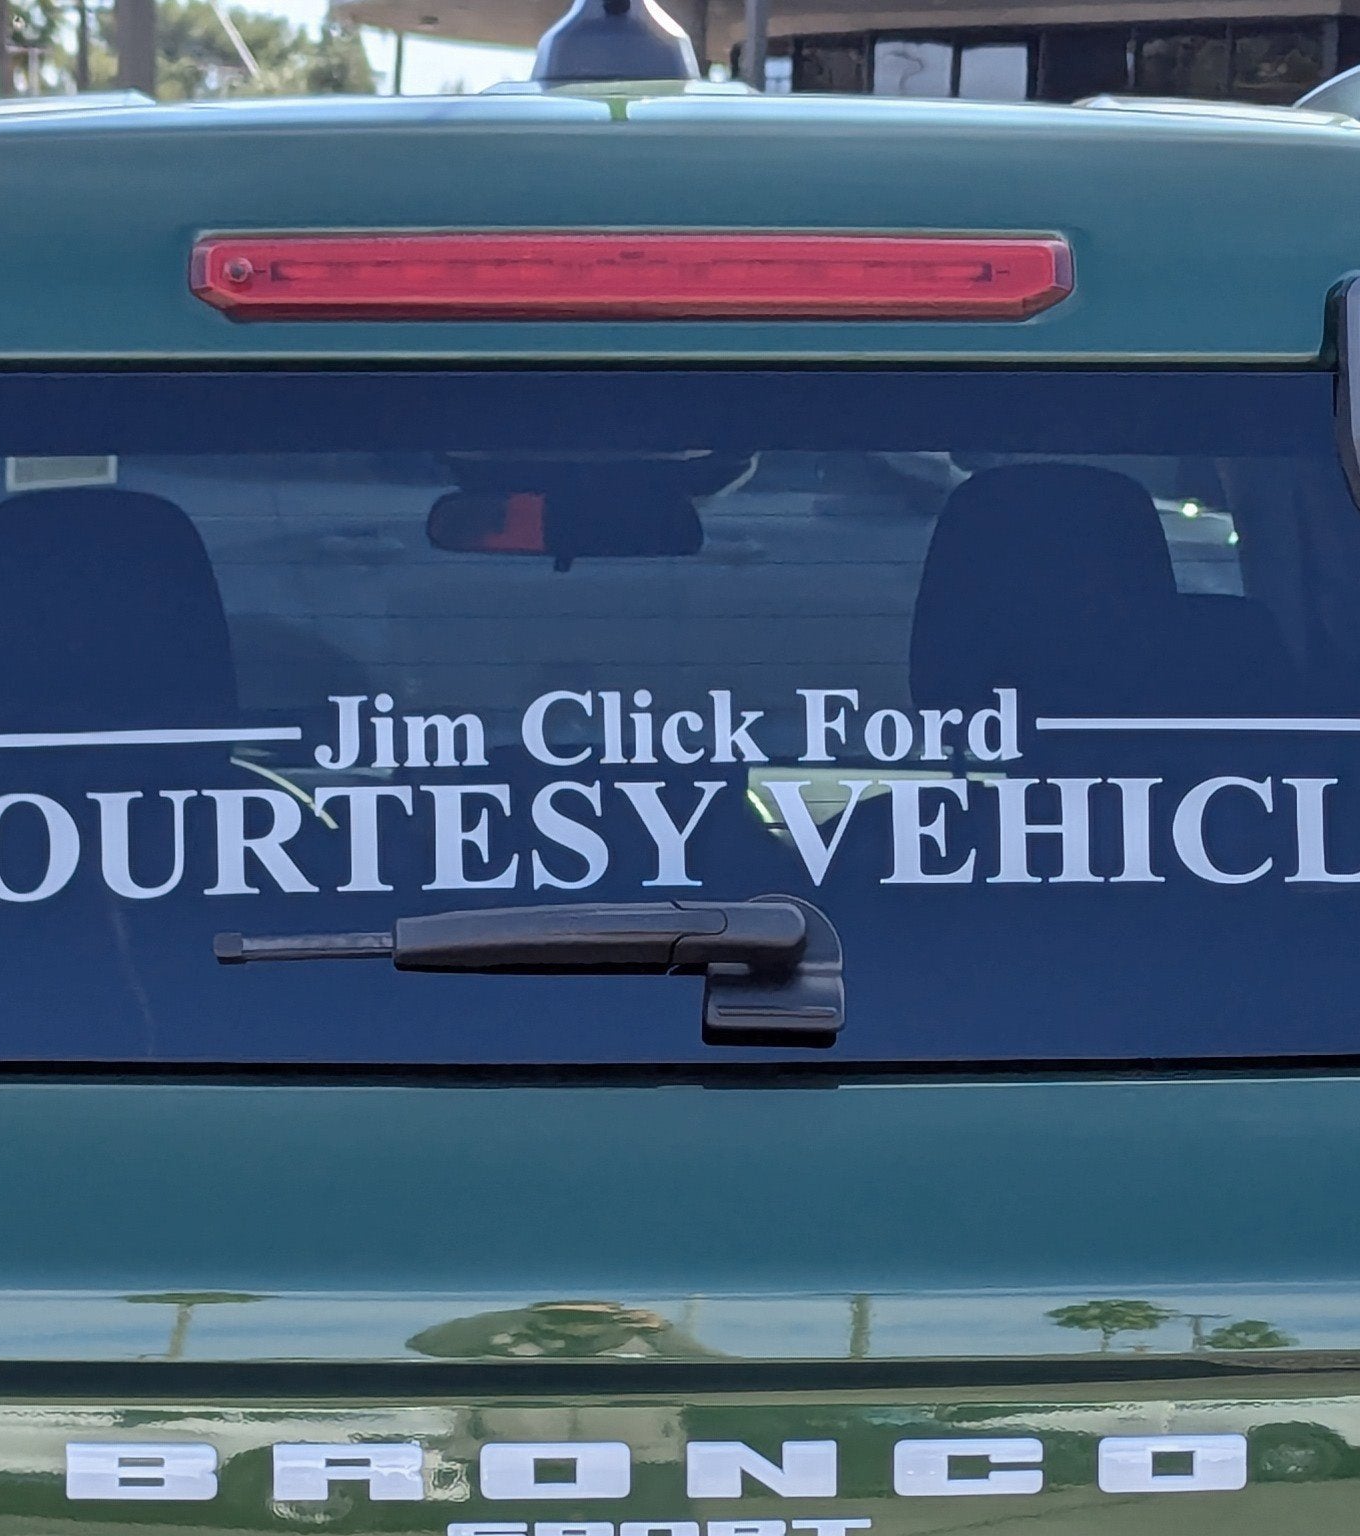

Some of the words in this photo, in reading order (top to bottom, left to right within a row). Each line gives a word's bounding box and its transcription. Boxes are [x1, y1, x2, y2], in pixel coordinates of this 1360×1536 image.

[314, 690, 489, 770] Jim
[521, 689, 769, 767] Click
[796, 688, 1023, 761] Ford
[65, 1433, 1248, 1502] BRONCO
